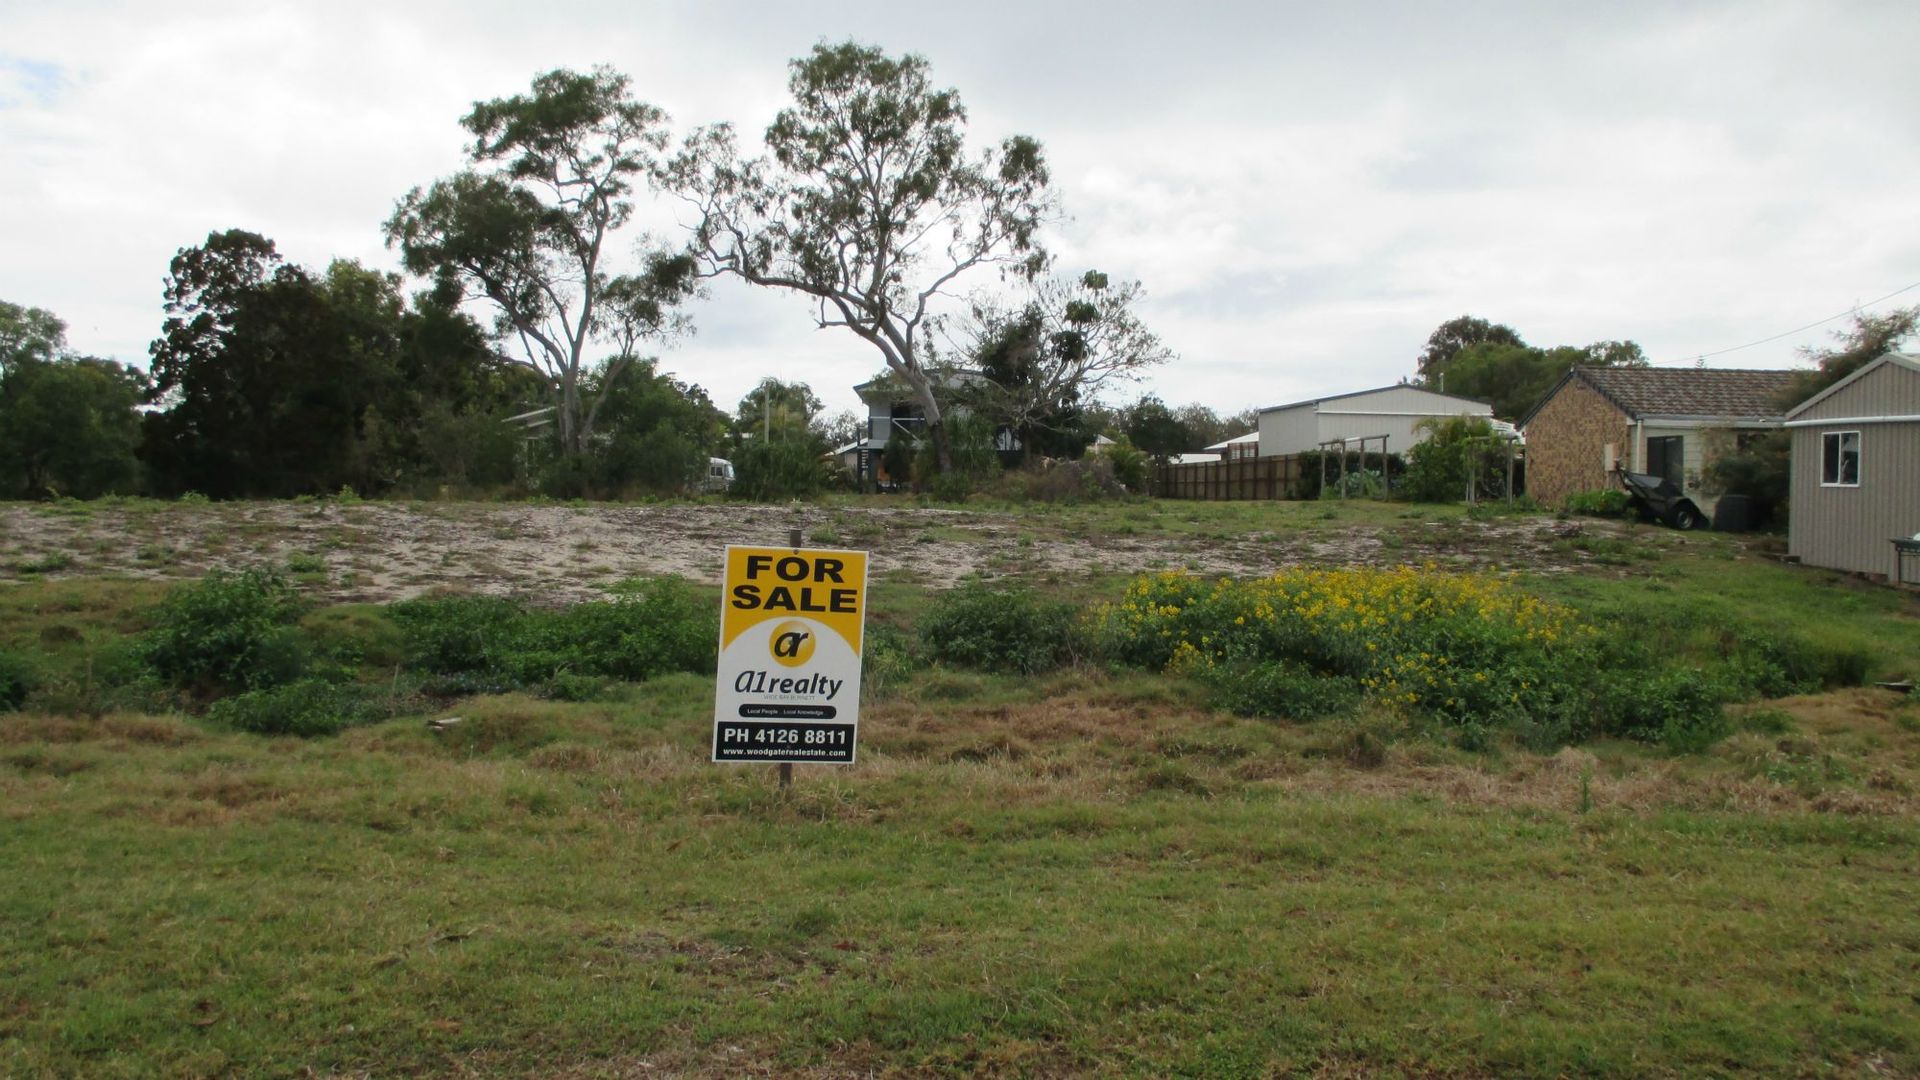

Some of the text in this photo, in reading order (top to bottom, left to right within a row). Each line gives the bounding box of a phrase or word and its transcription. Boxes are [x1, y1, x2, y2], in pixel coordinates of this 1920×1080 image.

[746, 555, 844, 583] FOR
[732, 584, 857, 613] SALE
[734, 670, 843, 700] a1realty
[724, 728, 846, 744] PH 4126 8811
[723, 748, 846, 757] www.woodgaterealestate.com
